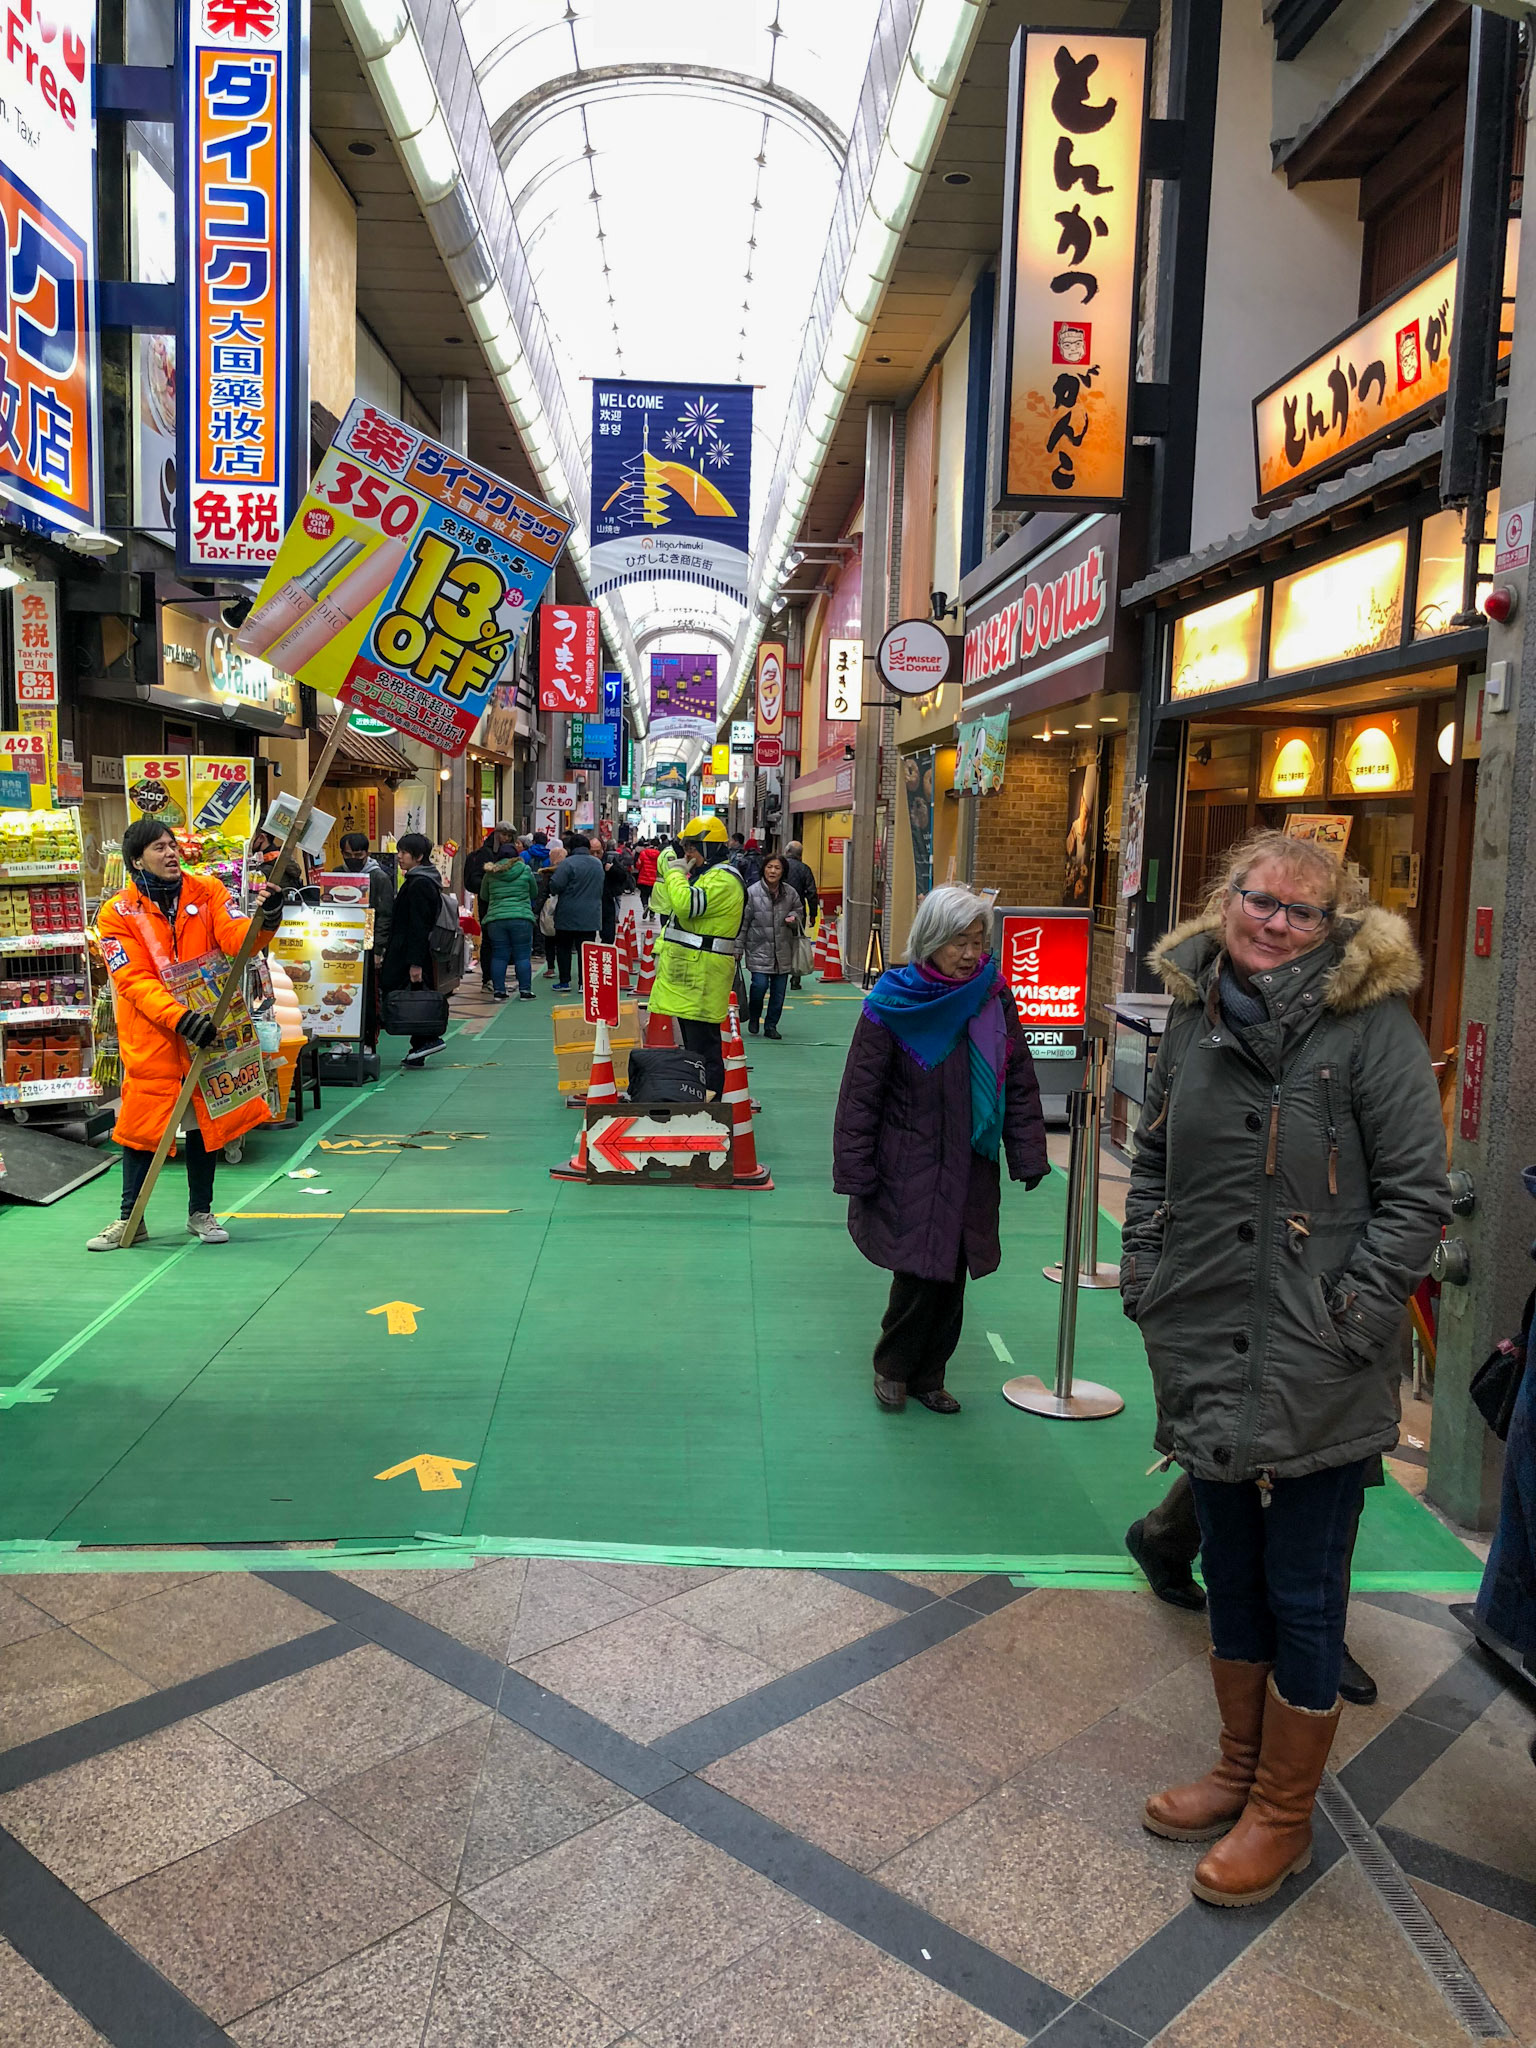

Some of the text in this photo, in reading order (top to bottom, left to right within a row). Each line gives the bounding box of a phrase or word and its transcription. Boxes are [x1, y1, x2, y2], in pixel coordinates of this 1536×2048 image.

[7, 6, 77, 132] Free
[203, 61, 275, 306] ダイコク
[1050, 45, 1118, 304] とんかつ
[599, 393, 664, 409] WELCOME
[600, 410, 622, 422] 欢迎
[1282, 354, 1387, 468] とんかつ
[600, 424, 622, 435] 환영
[1045, 364, 1101, 491] がんこ
[350, 407, 415, 472] 薬
[415, 446, 564, 548] ダイコクドラッグ
[193, 490, 280, 543] 免税
[308, 512, 330, 522] NOW
[604, 517, 614, 525] 1月
[307, 525, 331, 536] SALE!
[596, 525, 621, 535] 山焼き
[197, 542, 277, 562] Tax-Free
[655, 540, 704, 551] Higashimuki
[626, 553, 713, 572] ひがしむき商店街
[283, 584, 309, 612] DHC
[398, 532, 512, 662] 13%
[1021, 546, 1106, 659] Donut
[21, 594, 50, 648] 免税
[317, 603, 343, 629] DHC
[17, 650, 54, 659] Tax-Free
[376, 612, 498, 698] OFF
[552, 609, 588, 709] うまっしゅ
[906, 654, 943, 664] mister
[906, 664, 943, 673] Donut
[21, 672, 51, 688] 8%
[22, 686, 52, 698] OFF
[763, 667, 777, 717] ダイソー
[4, 736, 44, 753] 498
[97, 760, 116, 776] TAKE
[144, 761, 181, 778] 85
[206, 763, 247, 782] 748
[546, 784, 567, 794] 高級
[540, 797, 573, 807] くだもの
[602, 951, 613, 986] 段差に
[589, 950, 600, 1017] ご注意下さい
[1011, 985, 1081, 1001] mister
[1016, 1002, 1080, 1018] Donut
[1024, 1032, 1064, 1045] OPEN
